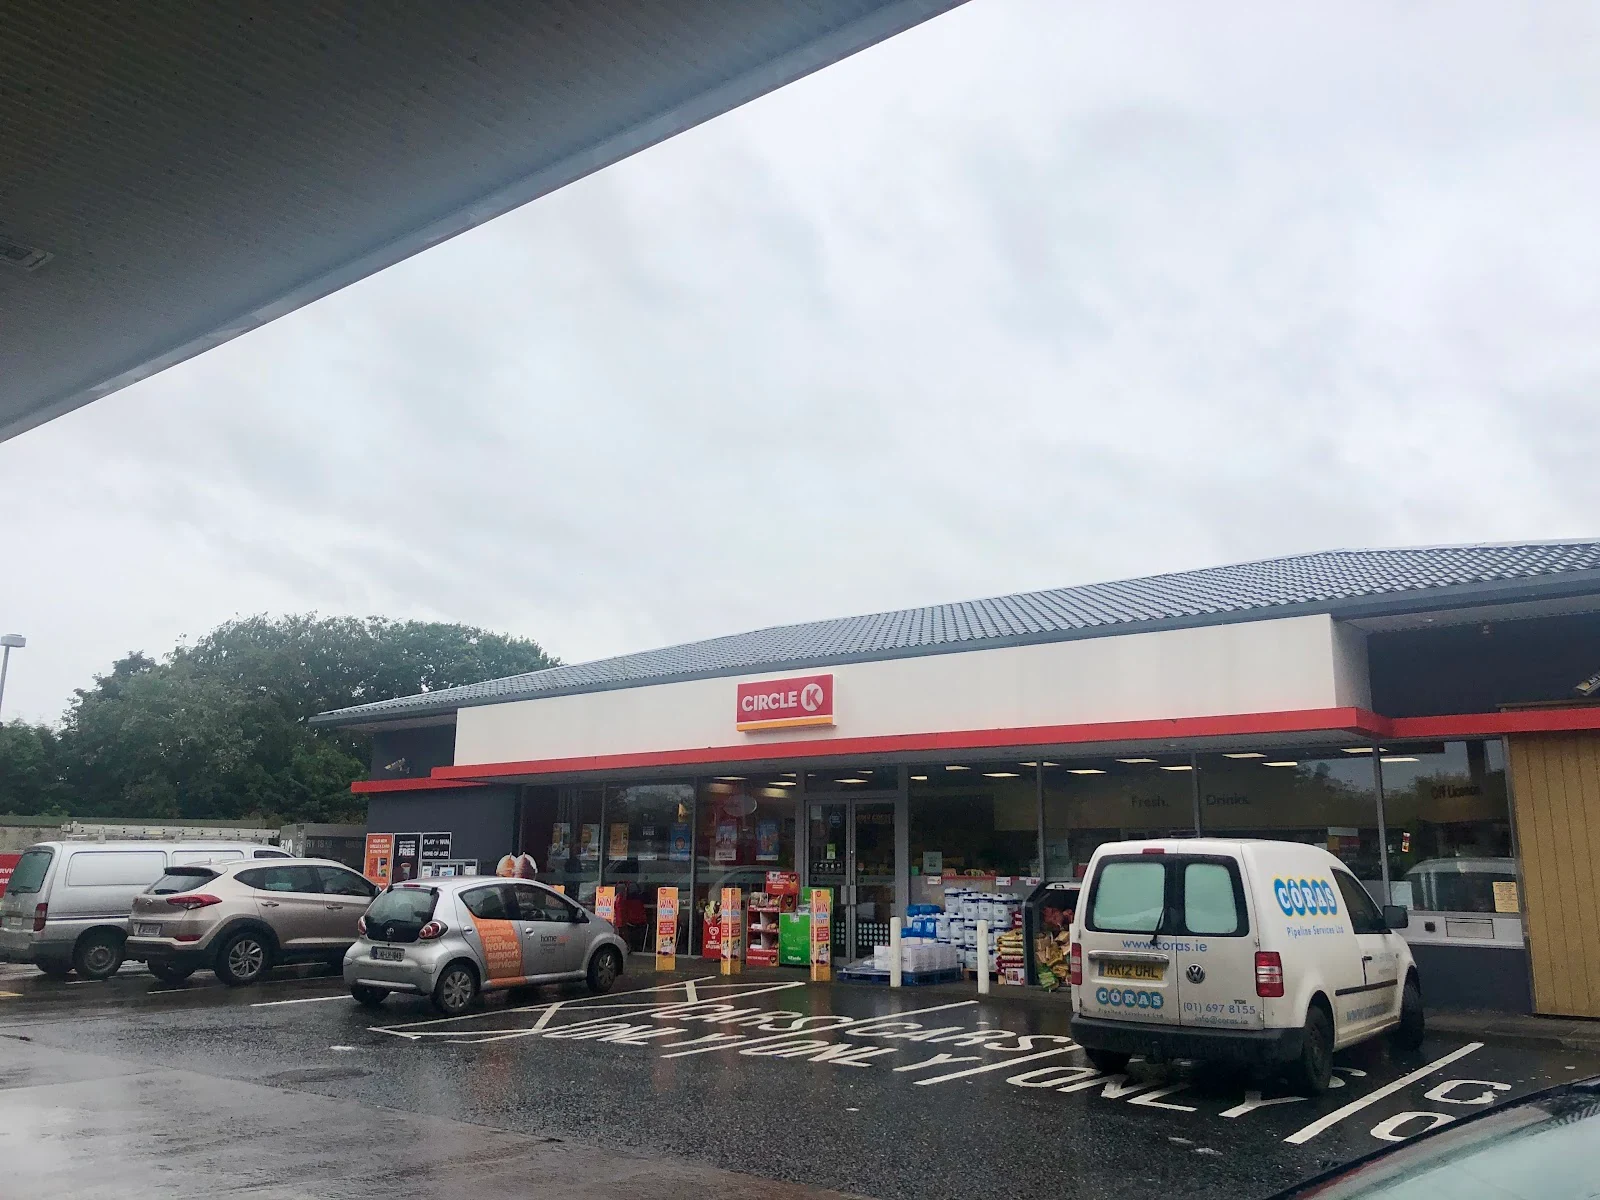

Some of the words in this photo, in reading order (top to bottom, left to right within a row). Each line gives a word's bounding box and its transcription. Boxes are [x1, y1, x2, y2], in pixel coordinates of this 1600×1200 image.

[741, 690, 798, 712] CIRCLE
[801, 683, 824, 712] K
[398, 847, 416, 856] FREE
[597, 898, 612, 907] WIN
[659, 899, 674, 909] WIN
[1286, 925, 1312, 939] Pipeline
[1312, 924, 1334, 935] Services
[1335, 924, 1344, 934] Ltd
[485, 940, 518, 952] worker
[487, 950, 519, 960] support
[1106, 963, 1132, 977] RK12
[1135, 964, 1159, 978] UHL
[1183, 1001, 1202, 1014] (01)
[1205, 1003, 1225, 1013] 697
[1228, 1004, 1256, 1015] 8155
[651, 1004, 854, 1031] CARS
[541, 1022, 747, 1048] ONLY
[845, 1022, 1072, 1051] CARS
[738, 1039, 982, 1072] ONLY
[1005, 1065, 1308, 1118] ONLY
